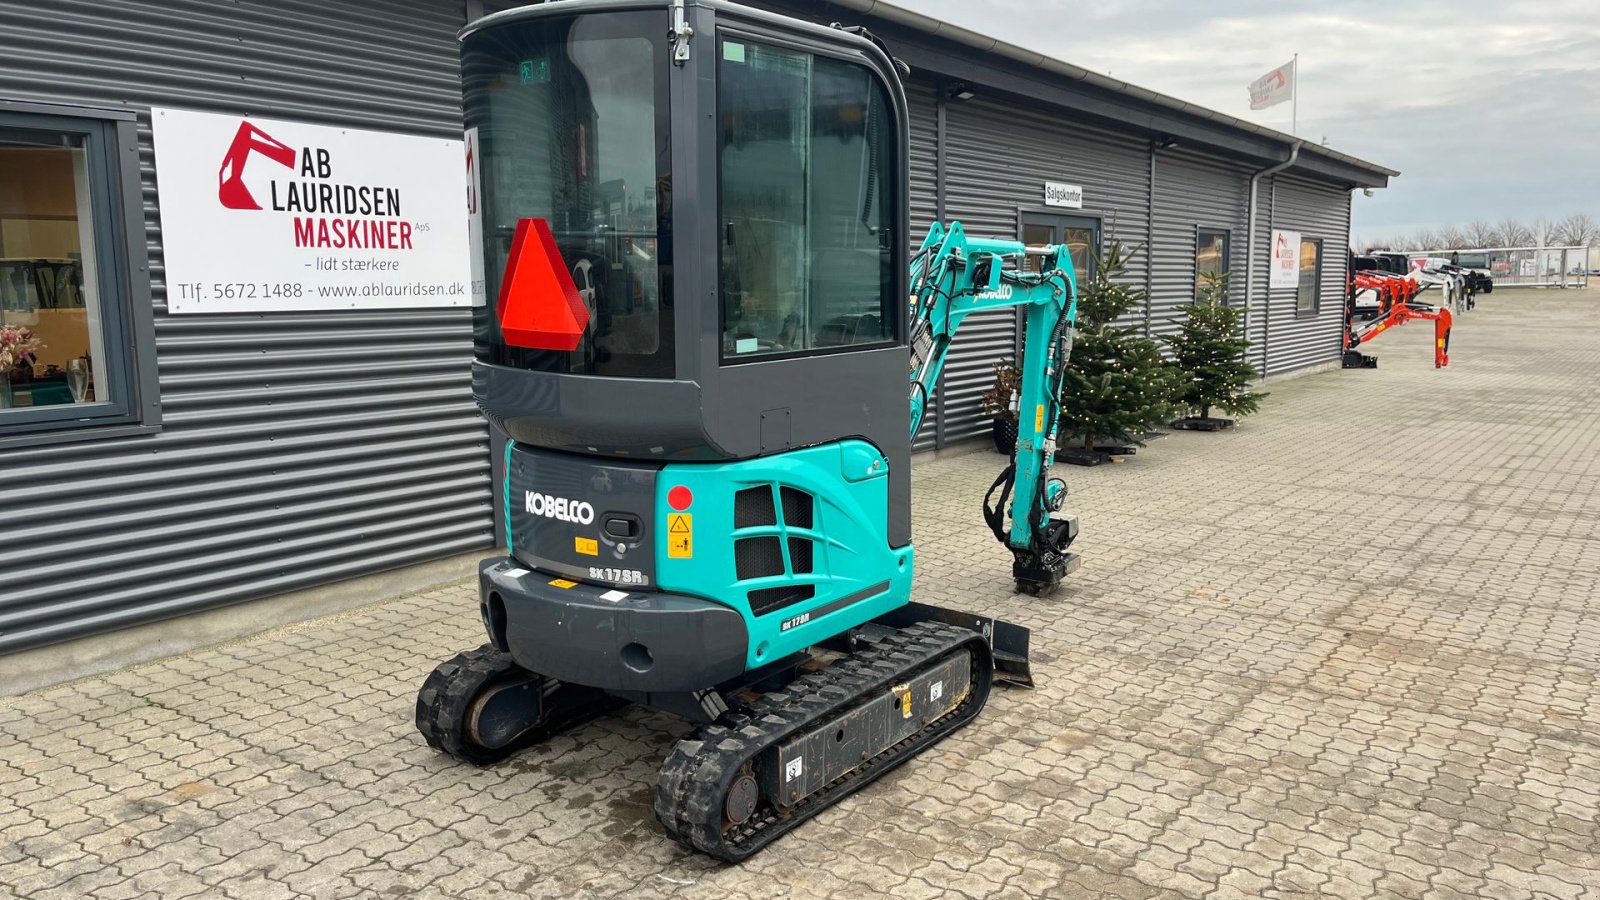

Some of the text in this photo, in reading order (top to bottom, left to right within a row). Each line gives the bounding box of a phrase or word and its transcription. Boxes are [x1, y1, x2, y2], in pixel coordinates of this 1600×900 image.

[301, 147, 331, 178] AB
[271, 180, 401, 216] LAURIDSEN
[1046, 186, 1081, 203] Salgskontor
[293, 217, 430, 249] MASKINER ApS
[316, 257, 338, 271] lidt
[341, 257, 400, 271] stærkere
[178, 282, 207, 303] Tlf.
[213, 283, 257, 299] 5672
[262, 282, 303, 298] 1488
[318, 282, 465, 297] www.ablauridsen.dk
[525, 490, 595, 525] KOBELCO
